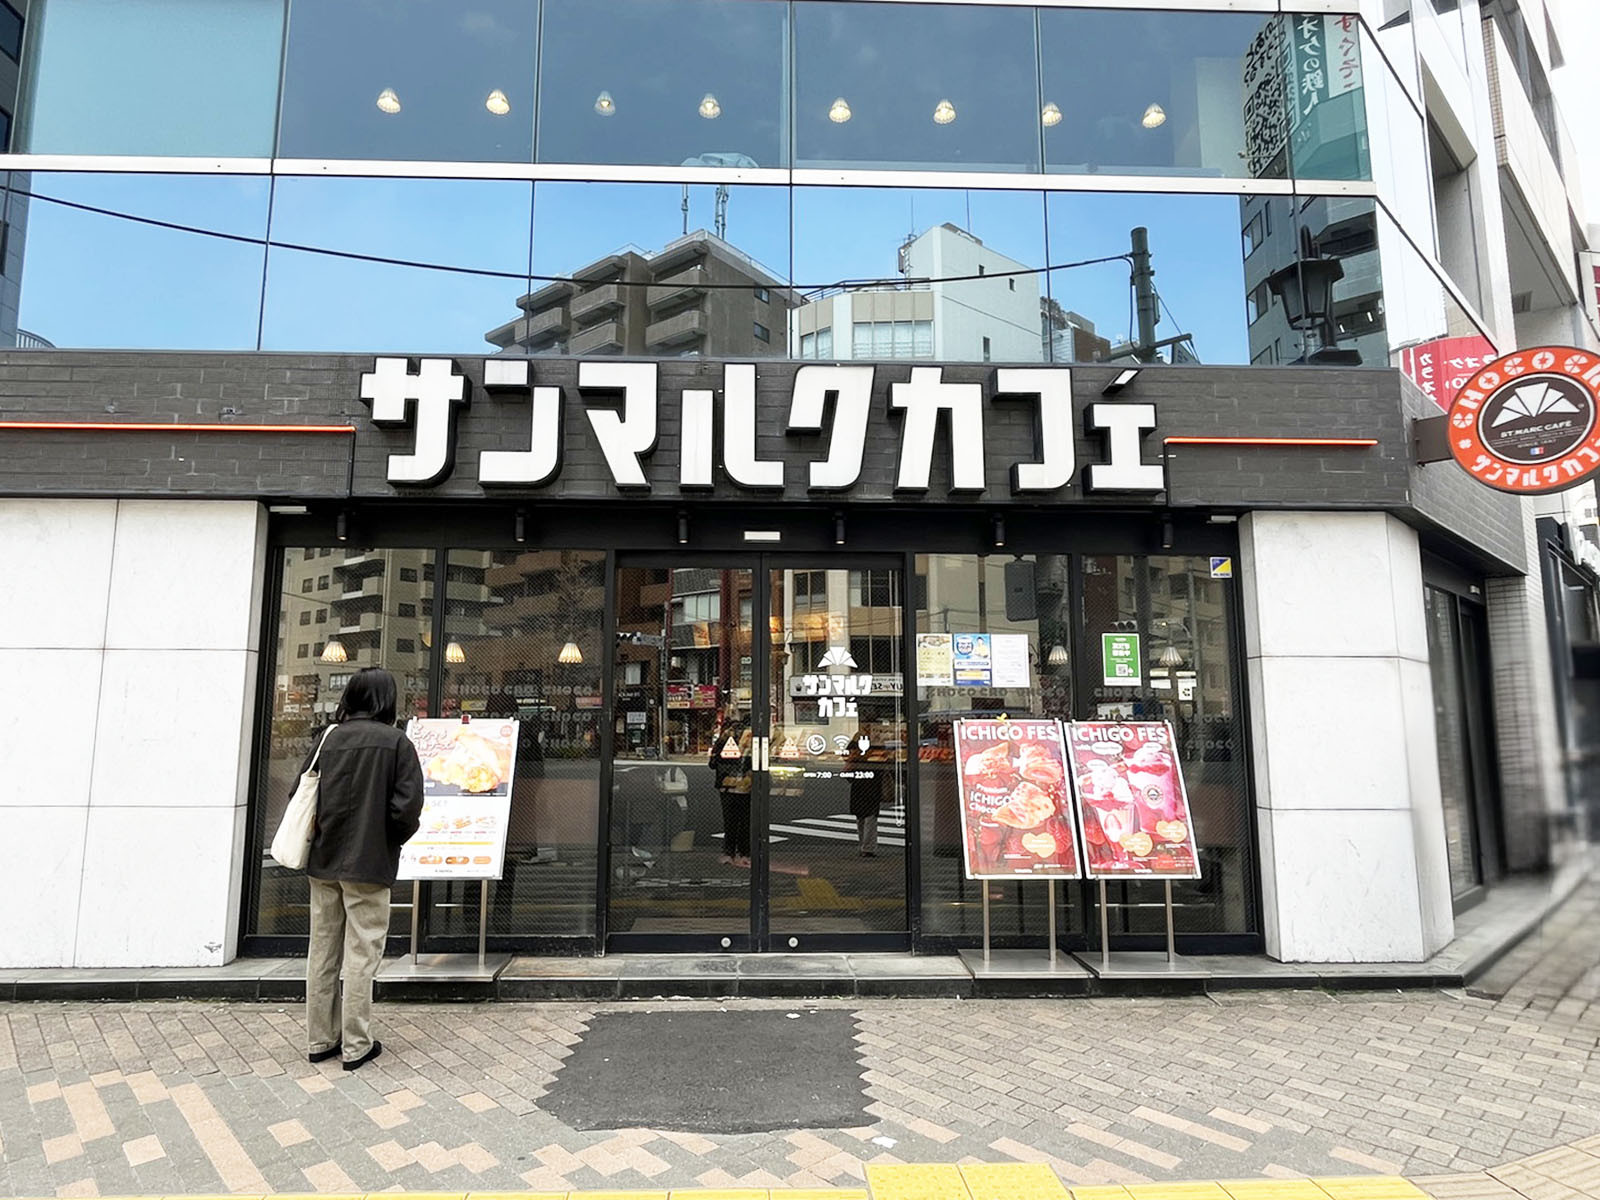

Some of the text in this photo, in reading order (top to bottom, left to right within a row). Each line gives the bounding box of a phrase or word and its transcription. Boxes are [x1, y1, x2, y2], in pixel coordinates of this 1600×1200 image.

[360, 357, 1166, 491] サンマルクカフェ
[803, 675, 872, 695] サンマルク
[818, 697, 858, 717] カフェ
[961, 725, 1060, 742] ICHIGO FES
[1073, 726, 1168, 744] ICHIGO FES
